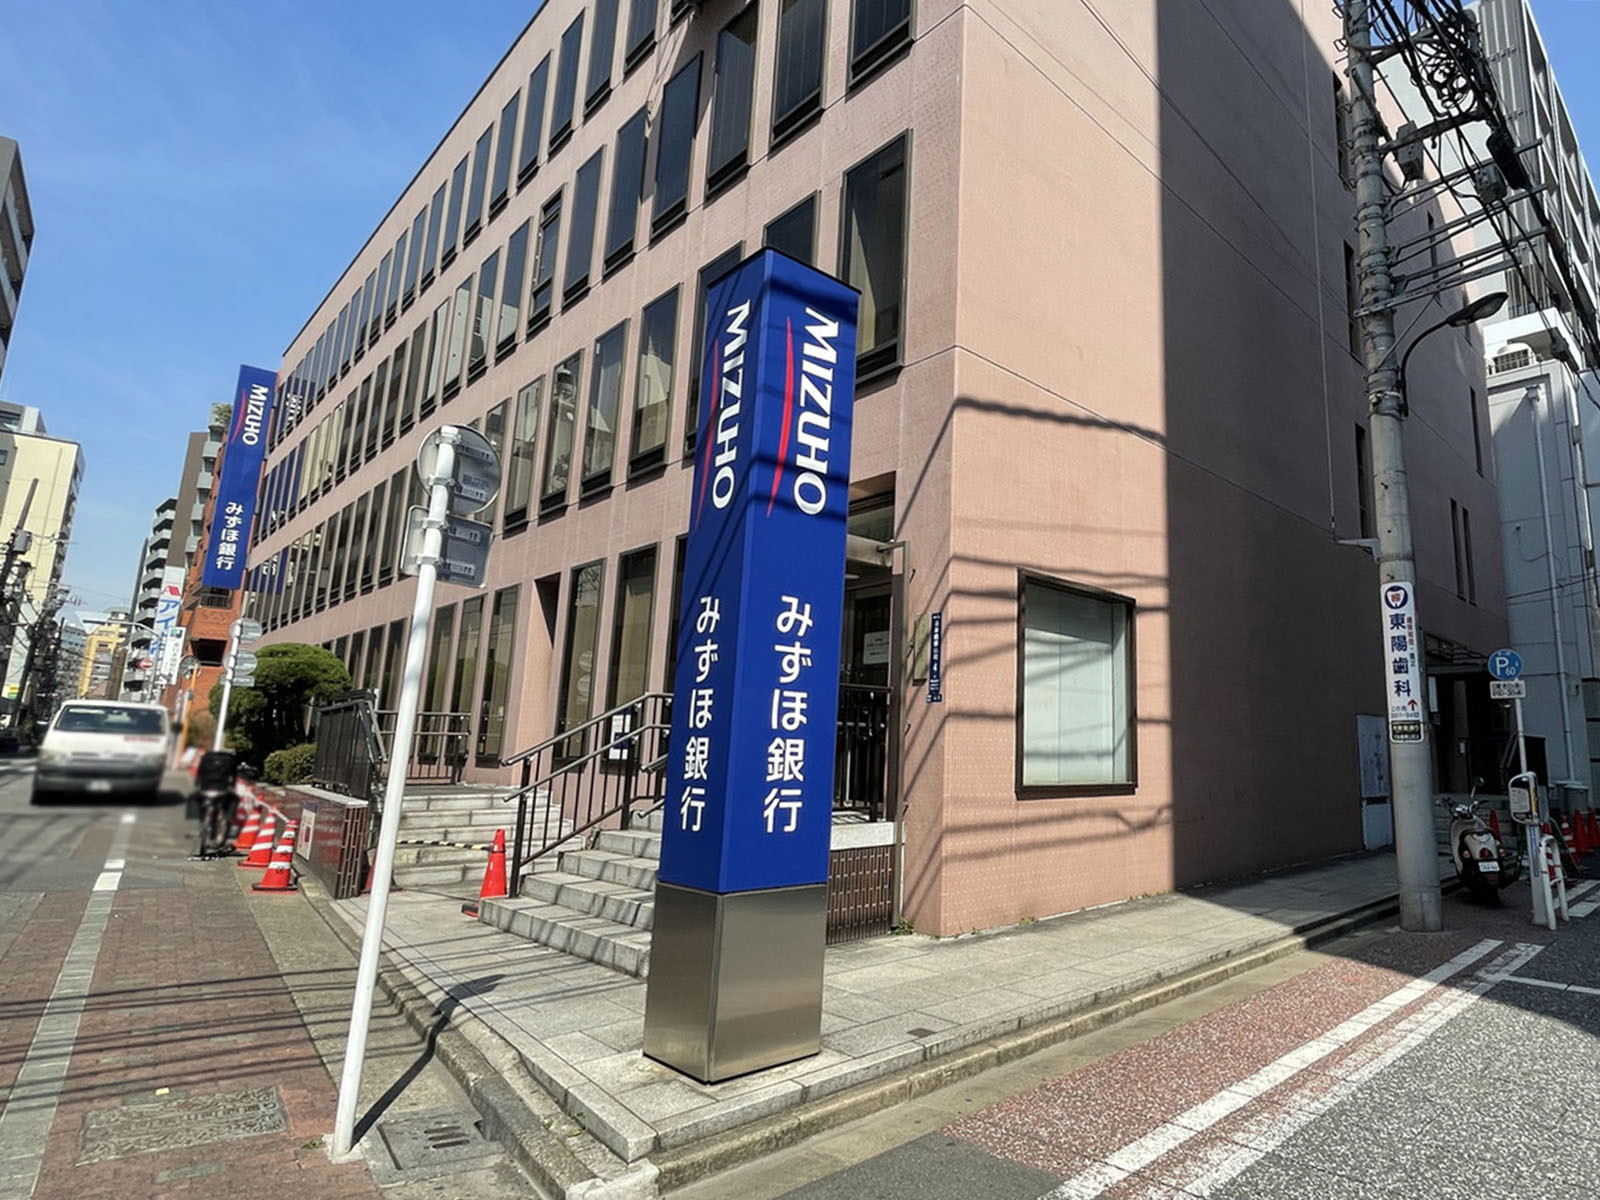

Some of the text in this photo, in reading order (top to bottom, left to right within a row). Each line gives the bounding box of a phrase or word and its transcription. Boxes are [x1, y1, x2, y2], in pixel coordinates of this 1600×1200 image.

[242, 383, 269, 446] MIZUHO
[712, 299, 750, 509] MIZUHO
[793, 306, 839, 515] MIZUHO
[216, 501, 244, 571] みずほ銀行
[680, 595, 721, 832] みずほ銀行
[763, 595, 814, 833] みずほ銀行
[1389, 613, 1412, 697] 東陽歯科
[1496, 656, 1509, 676] P
